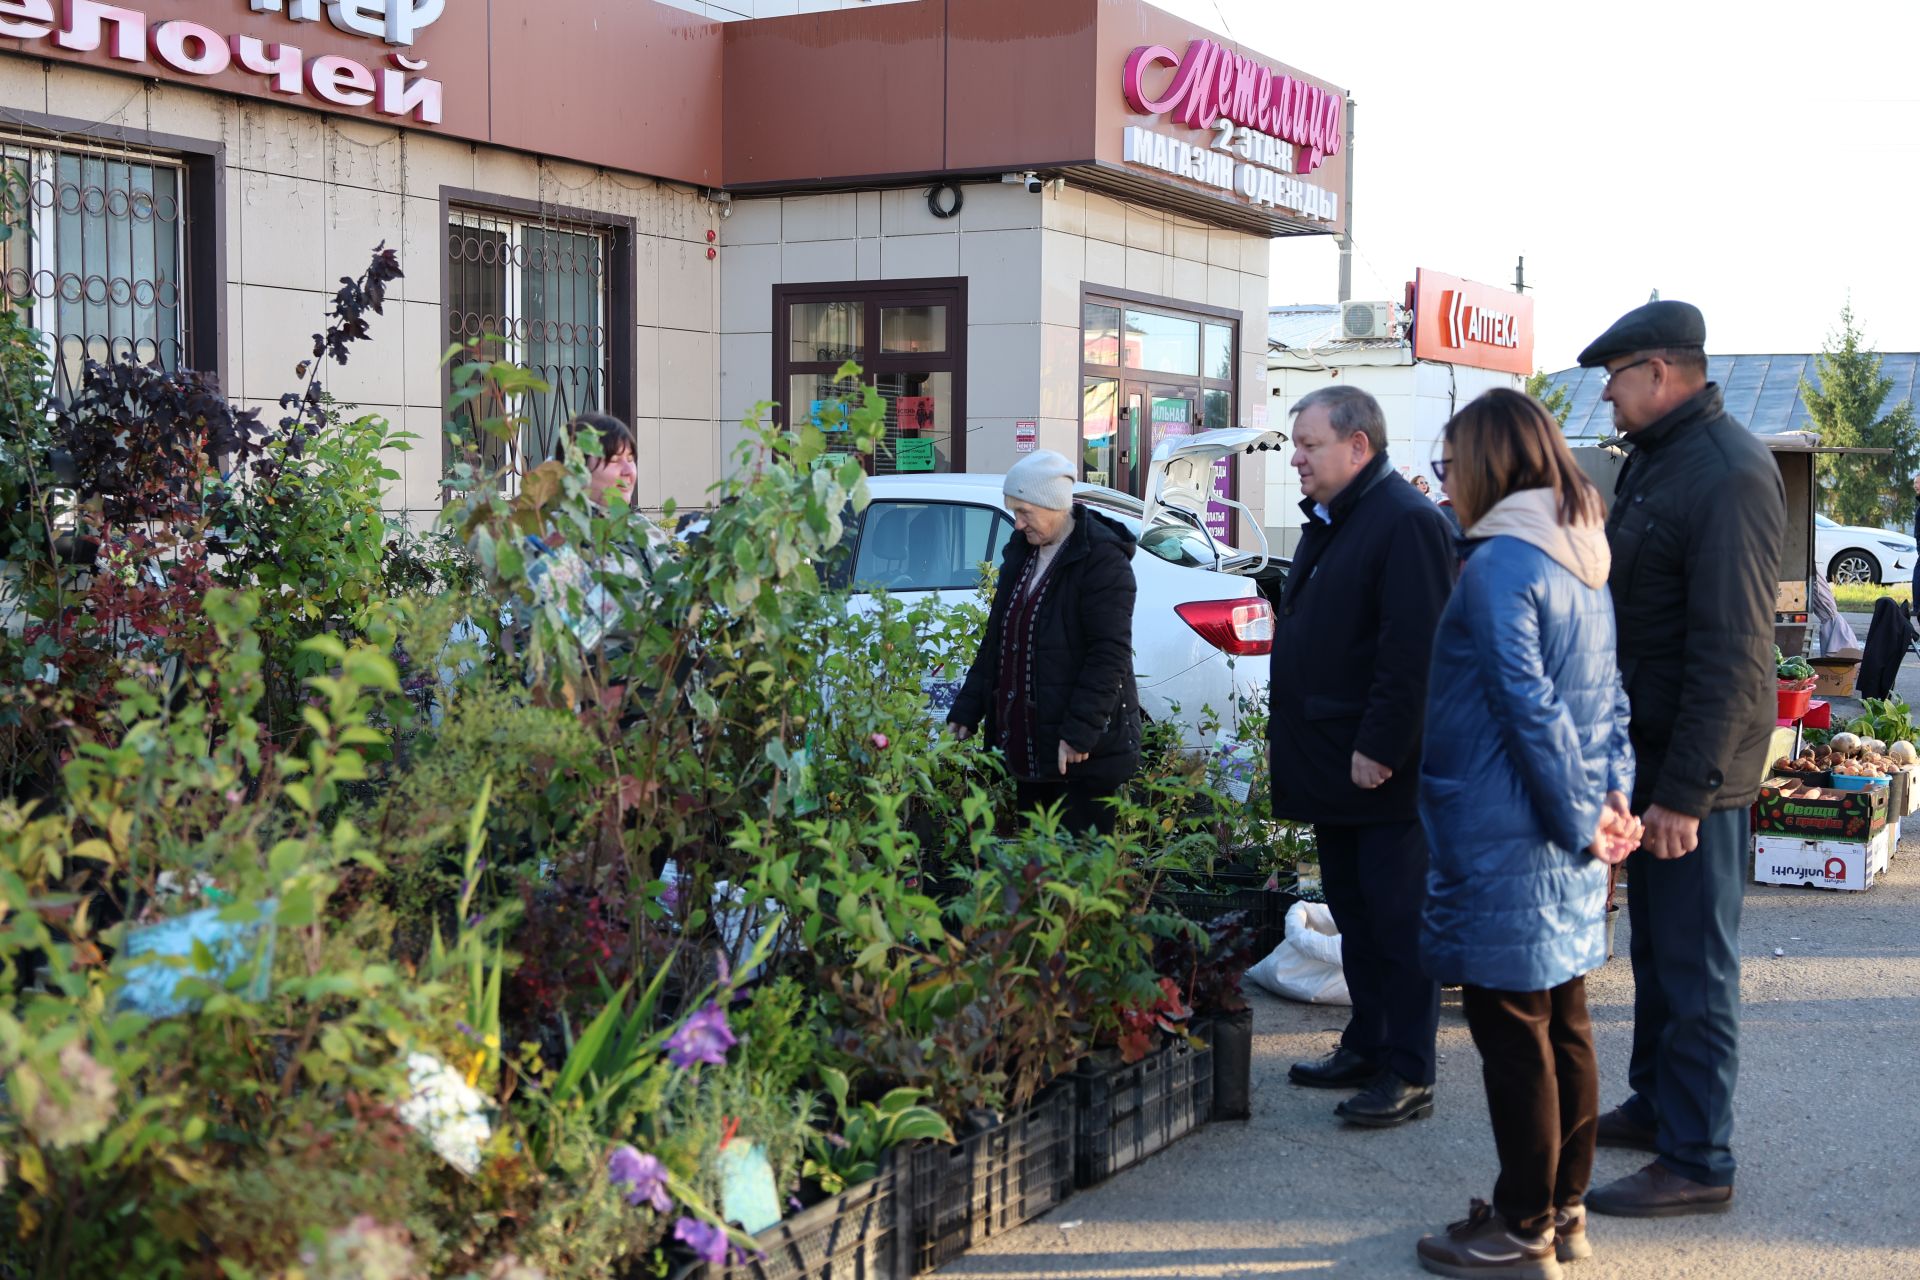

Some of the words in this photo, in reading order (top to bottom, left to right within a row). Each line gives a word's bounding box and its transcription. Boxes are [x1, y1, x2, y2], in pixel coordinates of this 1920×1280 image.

[1211, 118, 1235, 151] 2
[1234, 127, 1293, 172] ЭТАЖ
[1124, 126, 1235, 190] МАГАЗИН
[1235, 164, 1338, 222] ОДЕЖДЫ
[1465, 306, 1519, 348] АПТЕКА
[1152, 405, 1186, 422] ИЛЬНАЯ
[1771, 865, 1824, 879] unifrutti
